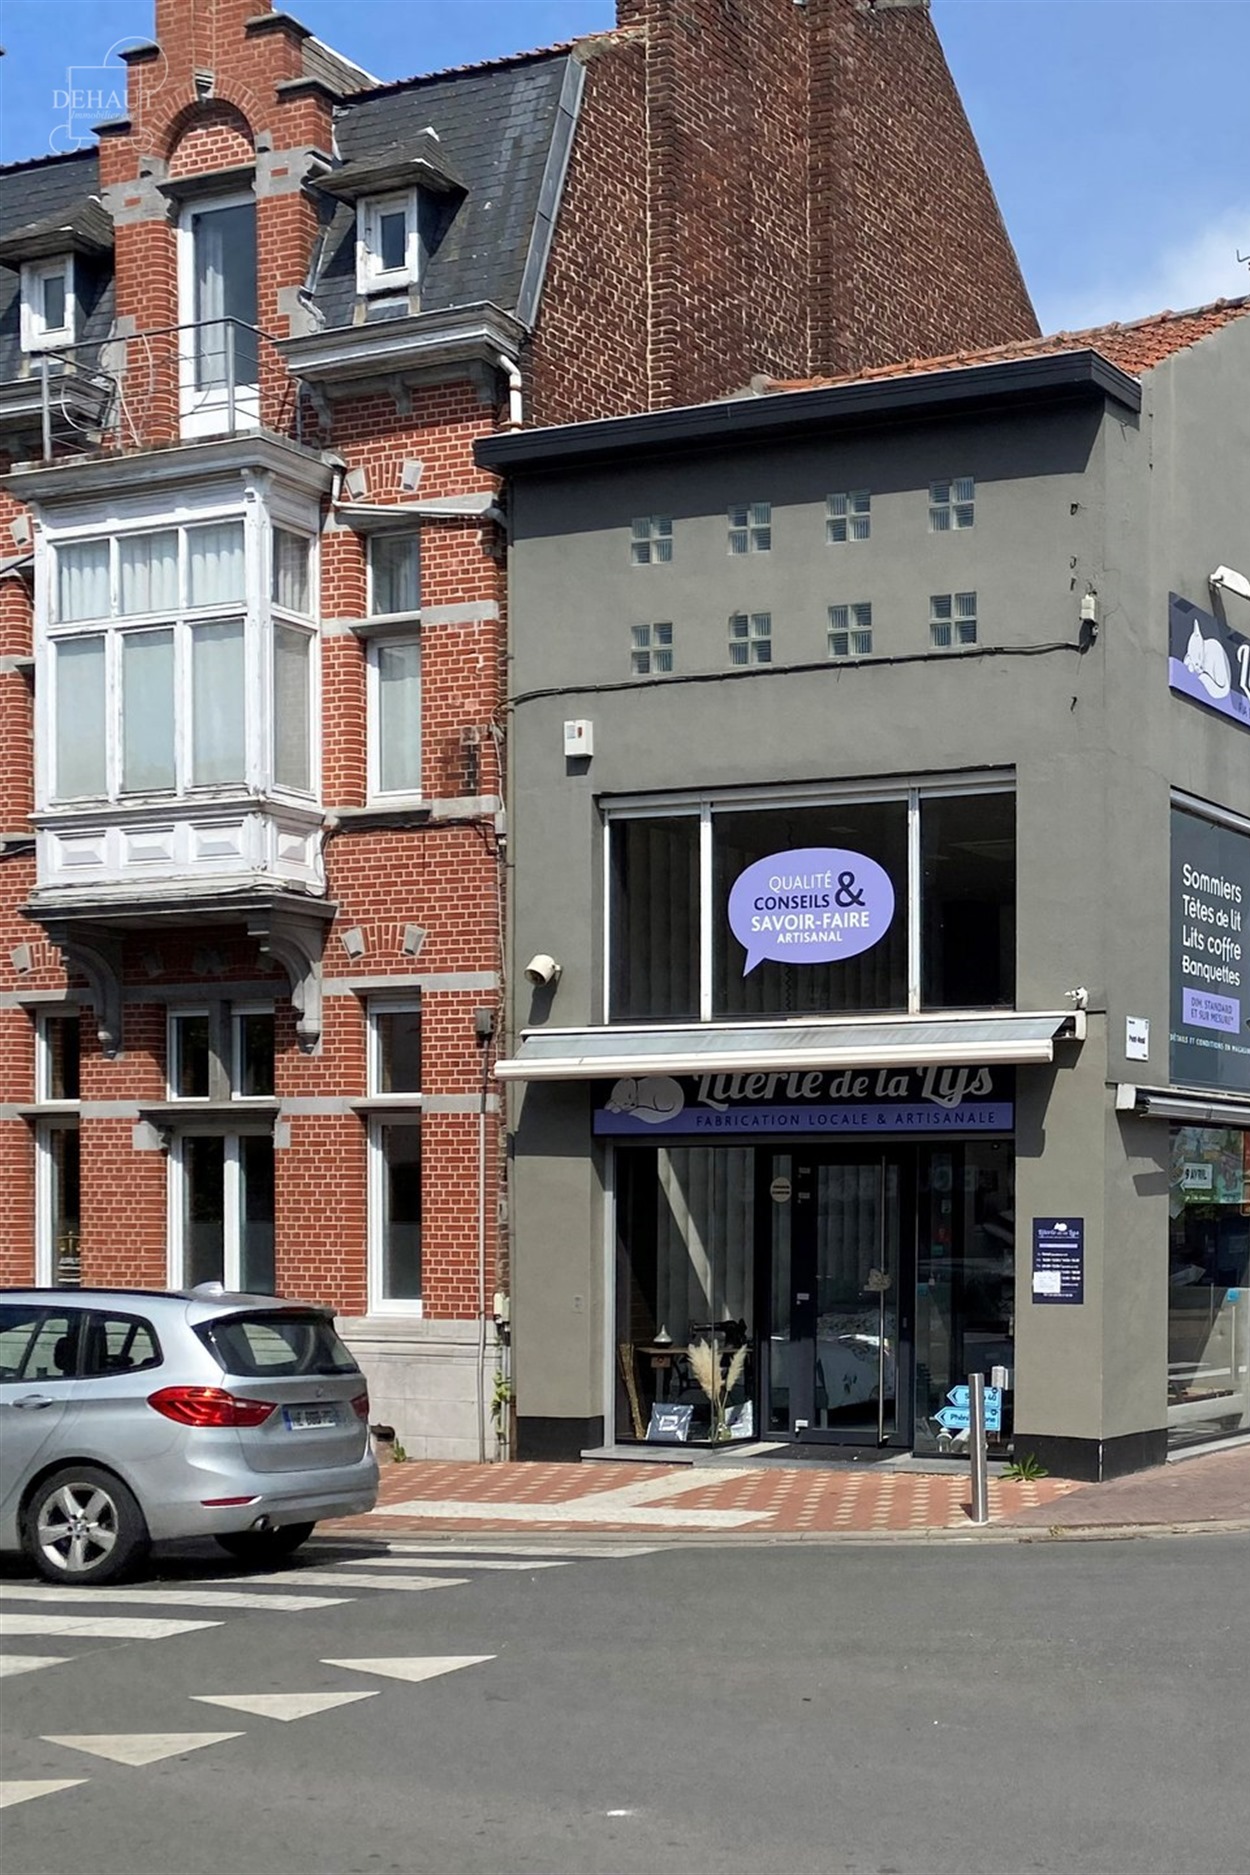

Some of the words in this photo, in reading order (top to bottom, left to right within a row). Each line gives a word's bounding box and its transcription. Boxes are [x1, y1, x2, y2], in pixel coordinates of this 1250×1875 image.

[769, 870, 832, 893] QUALITÉ
[834, 871, 866, 908] &
[1182, 863, 1242, 903] Sommiers
[754, 894, 830, 911] CONSEILS
[1182, 894, 1214, 924] Têtes
[1216, 909, 1229, 928] de
[1230, 908, 1242, 932] lit
[751, 911, 870, 932] SAVOIR-FAIRE
[777, 931, 843, 944] ARTISANAL
[1182, 924, 1205, 950] Lits
[1207, 936, 1242, 962] coffre
[1182, 954, 1240, 986] Banquettes
[1191, 1008, 1198, 1018] ET
[1199, 1010, 1209, 1021] SUR
[1204, 1000, 1232, 1015] STANDARD
[829, 1070, 869, 1098] de
[875, 1069, 910, 1097] la
[916, 1066, 993, 1109] Lys
[696, 1114, 800, 1127] FABRICATION
[809, 1113, 868, 1126] LOCALE
[877, 1112, 887, 1125] &
[895, 1111, 996, 1125] ARTISANALE
